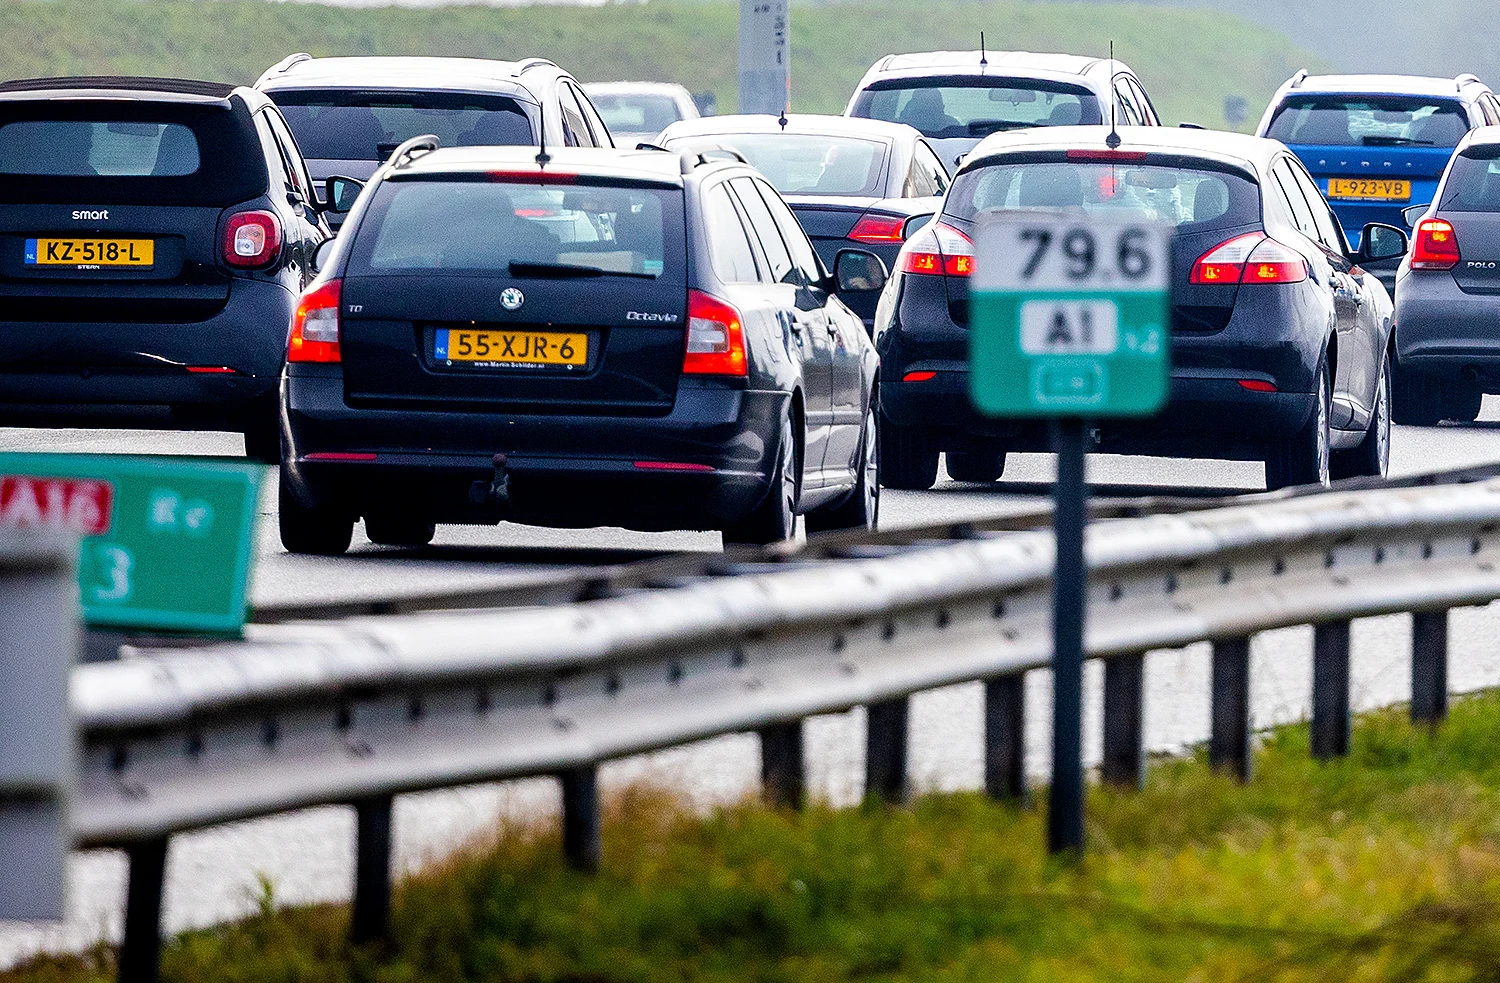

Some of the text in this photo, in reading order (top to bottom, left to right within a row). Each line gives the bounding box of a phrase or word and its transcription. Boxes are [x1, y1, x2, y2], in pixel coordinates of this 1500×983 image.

[1335, 181, 1403, 196] L-923-VB
[72, 209, 109, 220] smart
[46, 241, 141, 262] KZ-518-L
[1017, 226, 1152, 282] 79.6
[1467, 261, 1496, 270] POLO
[625, 311, 678, 322] Octavia
[1044, 309, 1094, 346] A1
[436, 346, 446, 354] NL
[458, 333, 574, 360] 55-XJR-6
